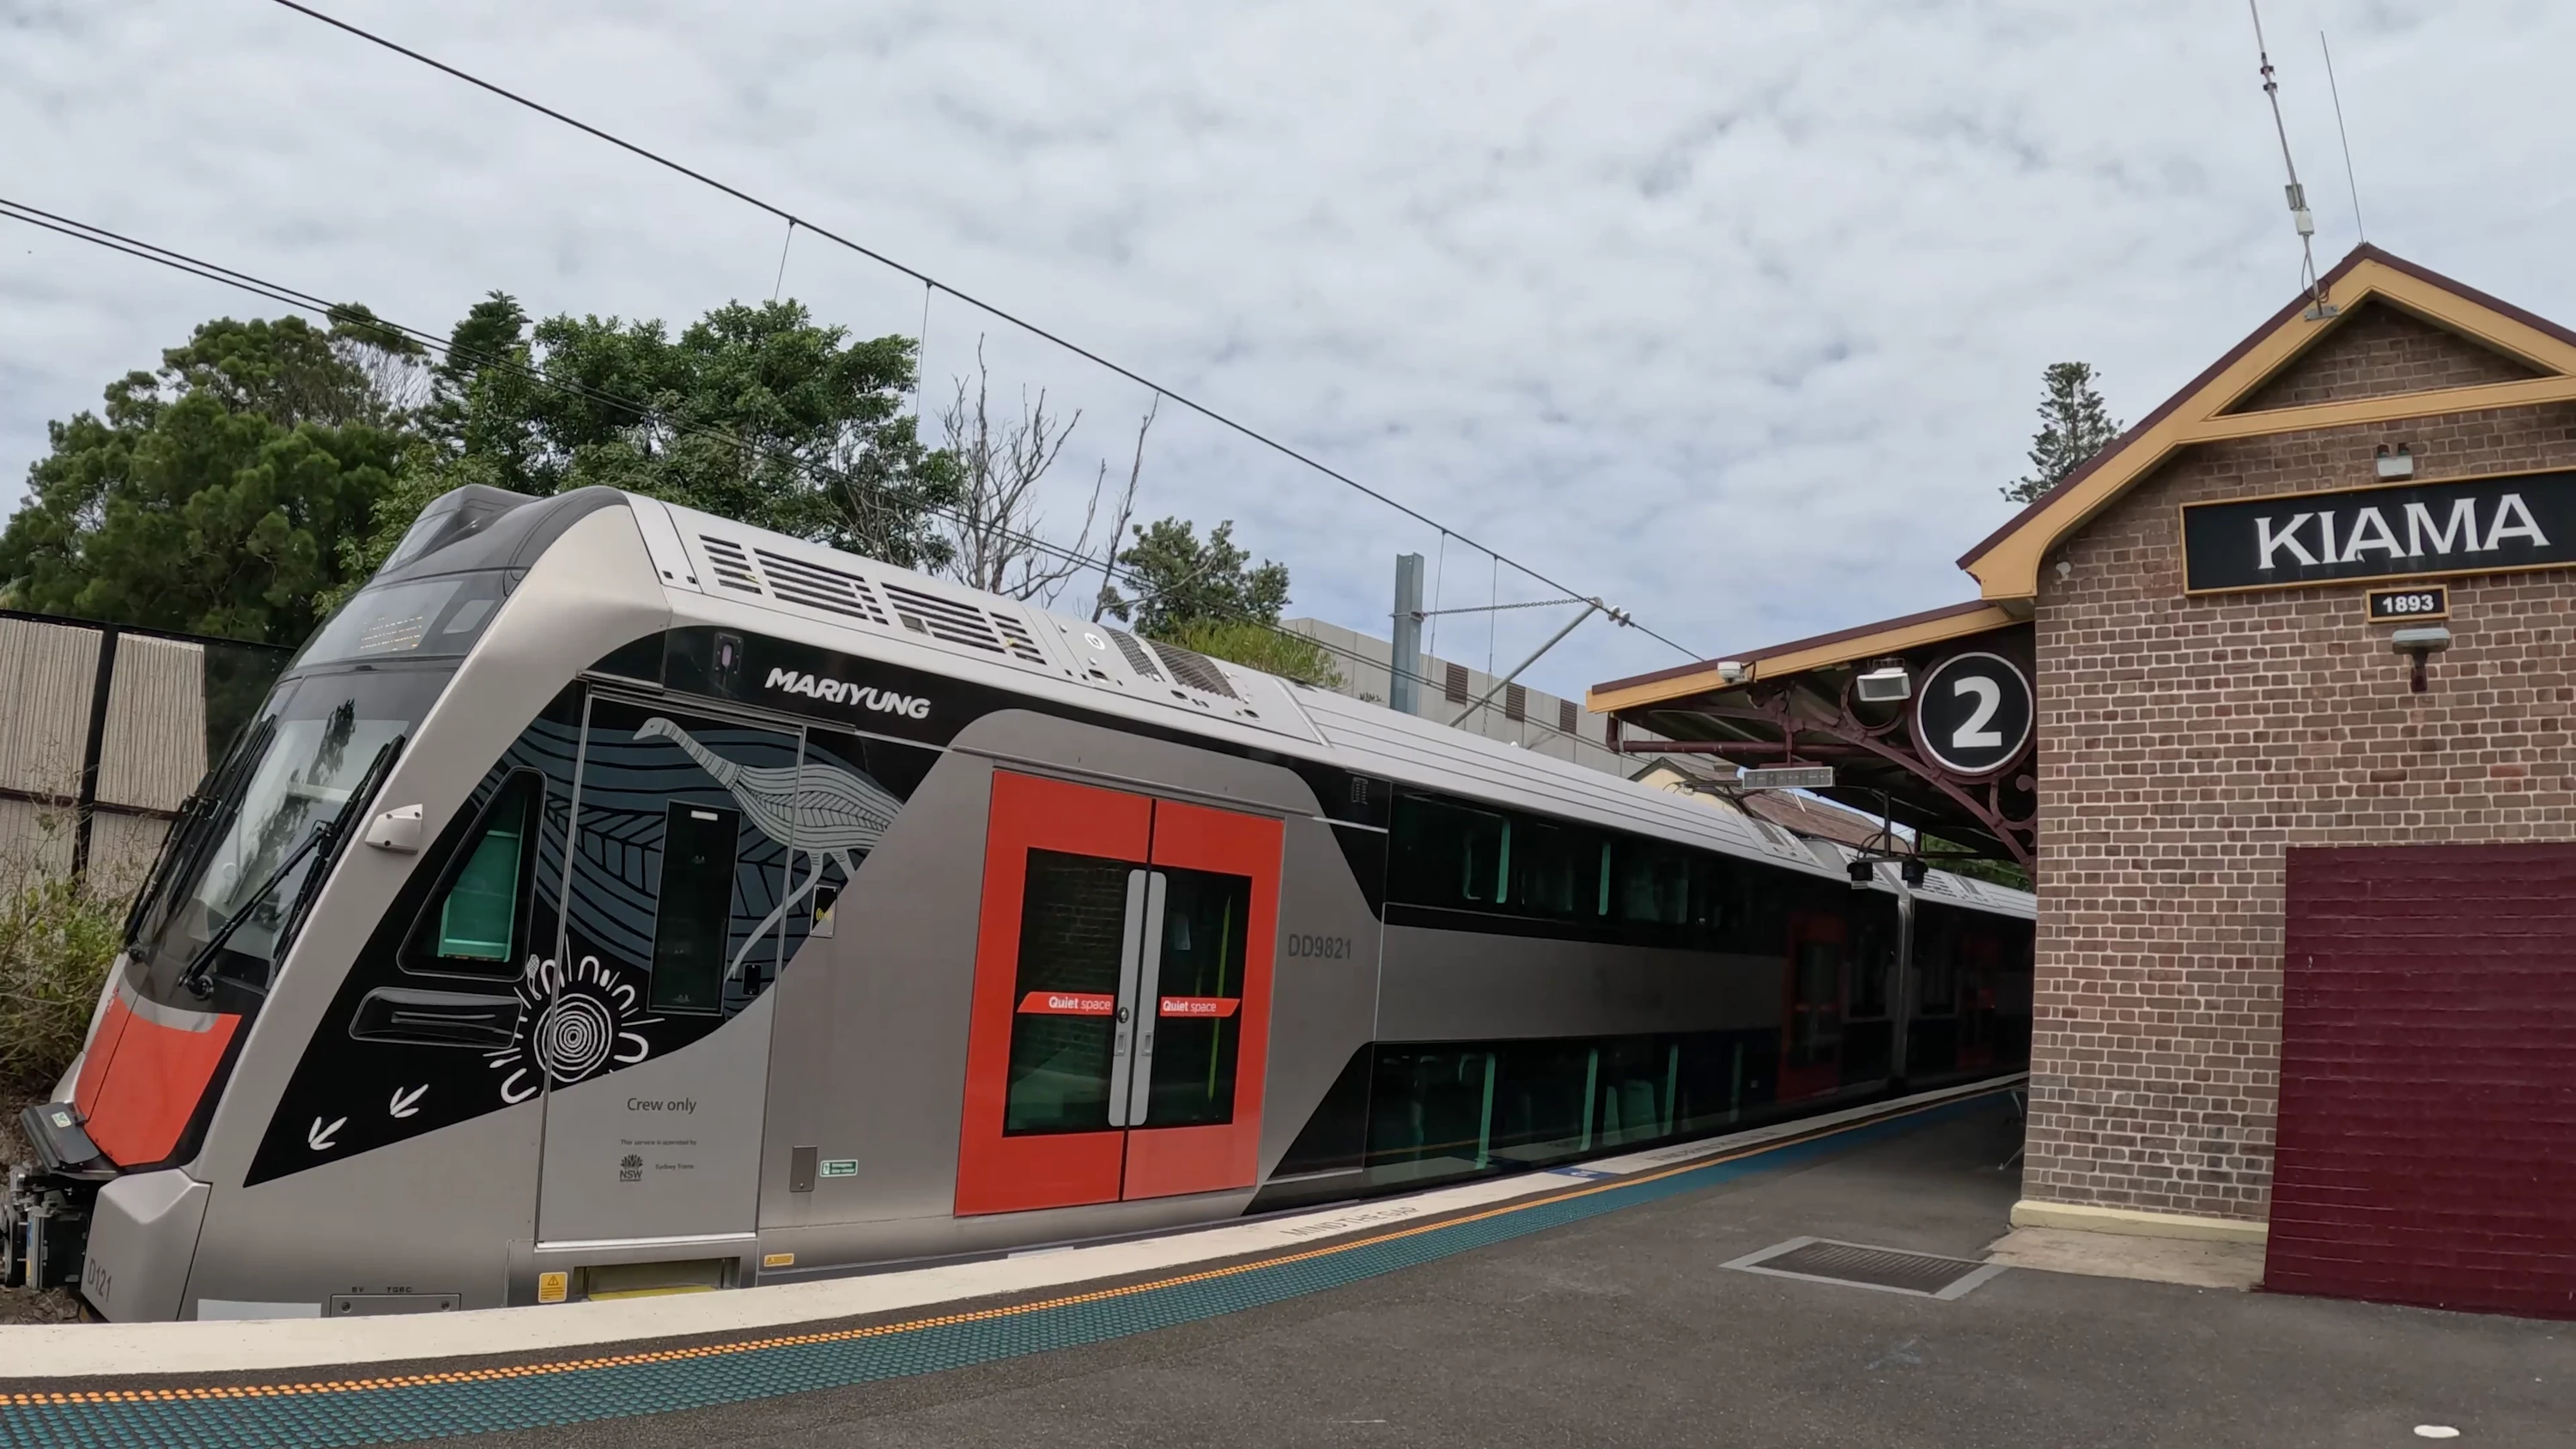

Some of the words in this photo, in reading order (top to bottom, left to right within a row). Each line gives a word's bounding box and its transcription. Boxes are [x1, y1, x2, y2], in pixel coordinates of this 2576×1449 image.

[2254, 493, 2551, 570] KIAMA
[2383, 594, 2434, 613] 1893
[764, 667, 931, 719] MARIYUNG
[1953, 676, 2002, 748] 2
[1288, 933, 1352, 960] DD9821
[1048, 996, 1078, 1009] Quiet
[1081, 998, 1111, 1012] space
[1163, 999, 1189, 1012] Quiet
[1190, 1001, 1217, 1014] space
[627, 1097, 663, 1111] Crew
[667, 1097, 696, 1114] only
[620, 1169, 642, 1179] NSW
[88, 1258, 112, 1303] D121
